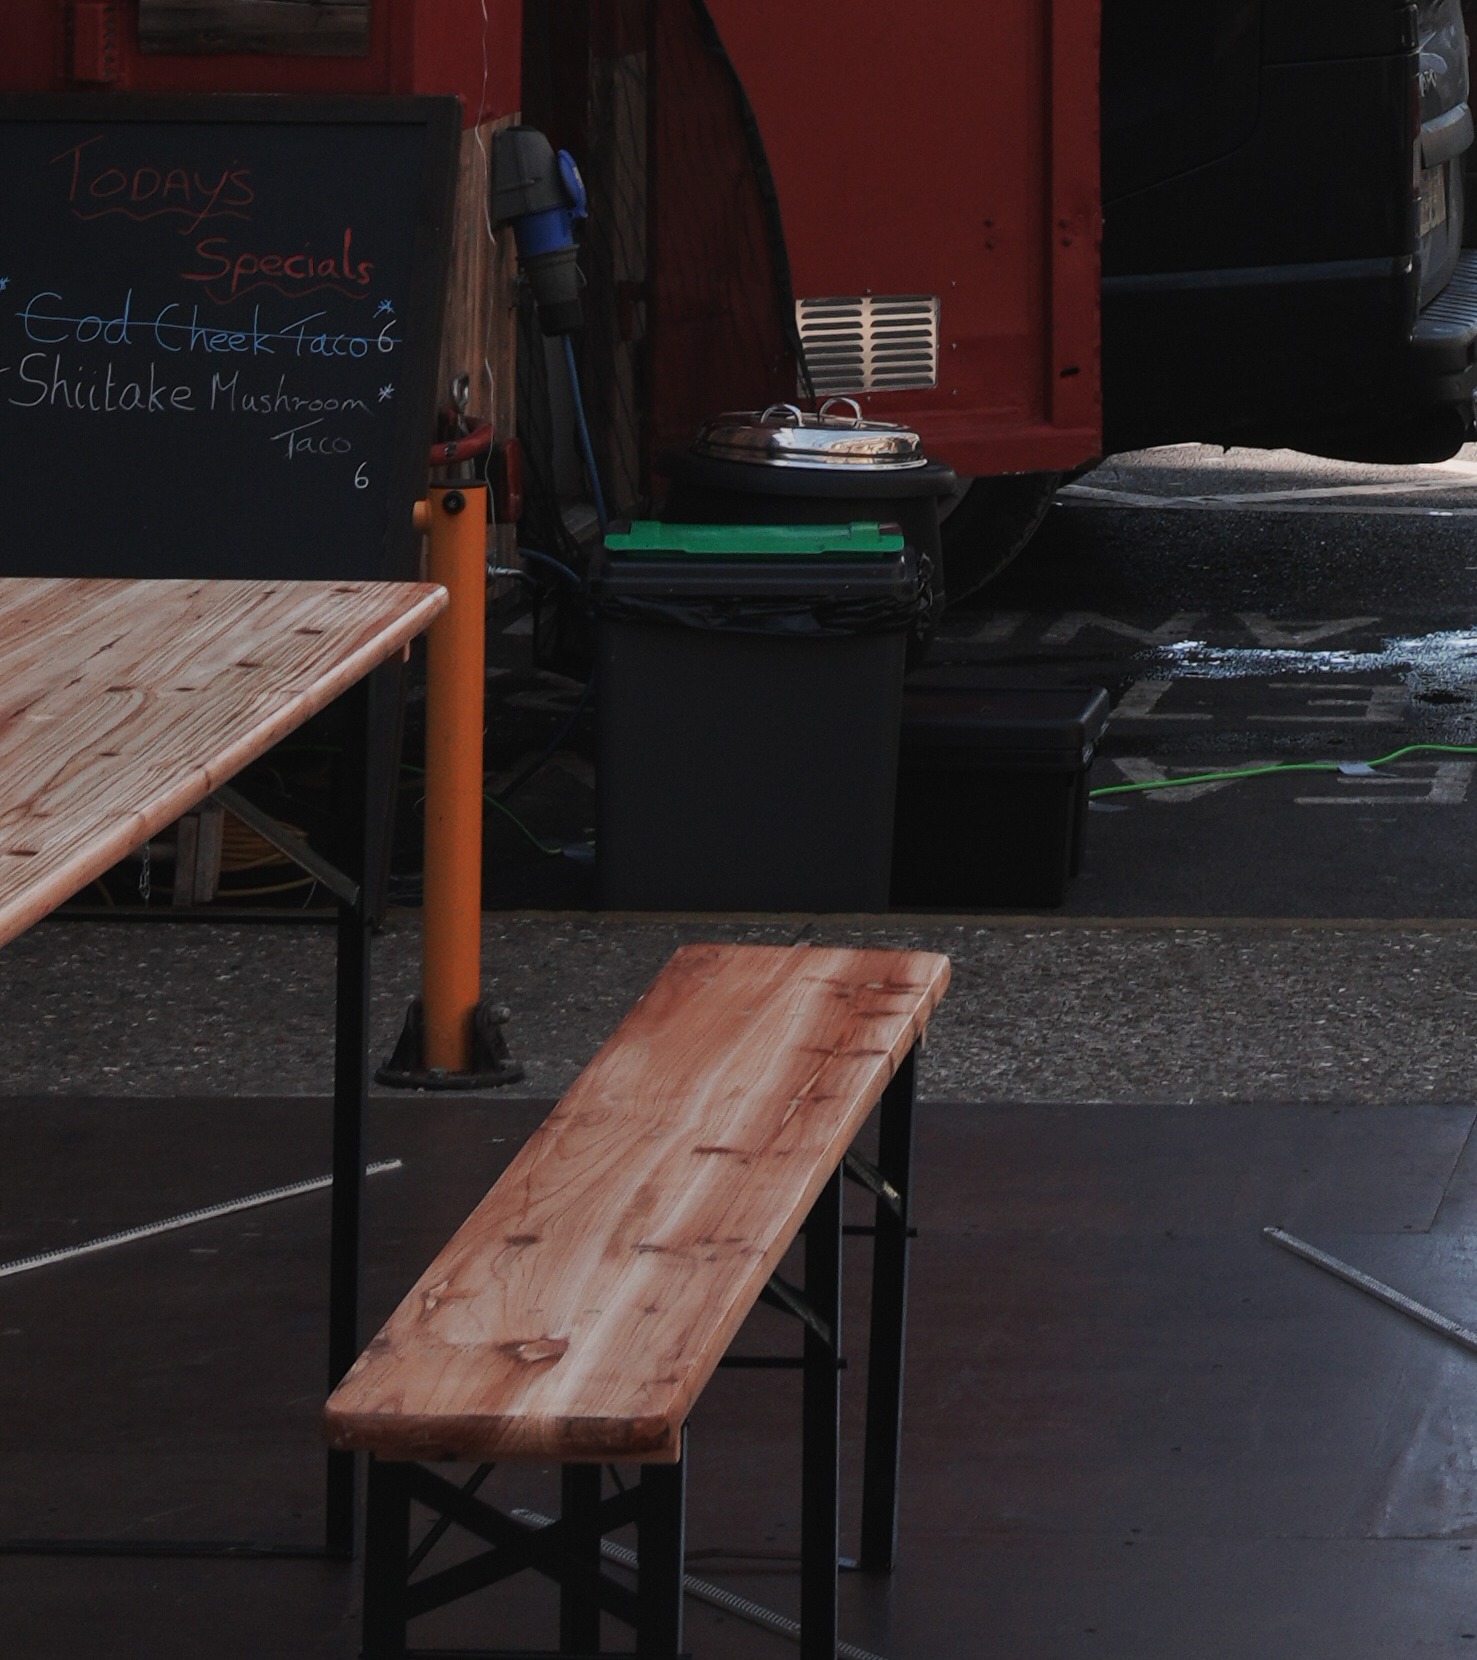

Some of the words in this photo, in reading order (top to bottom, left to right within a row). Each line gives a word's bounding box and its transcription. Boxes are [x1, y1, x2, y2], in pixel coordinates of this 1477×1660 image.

[180, 225, 376, 294] Specials
[24, 287, 133, 345] Cod
[154, 302, 276, 354] Cheek
[280, 310, 368, 358] Taco
[9, 352, 197, 412] Shiitake
[210, 370, 375, 417] Mushroom
[270, 417, 352, 460] Taco
[353, 461, 370, 490] 6
